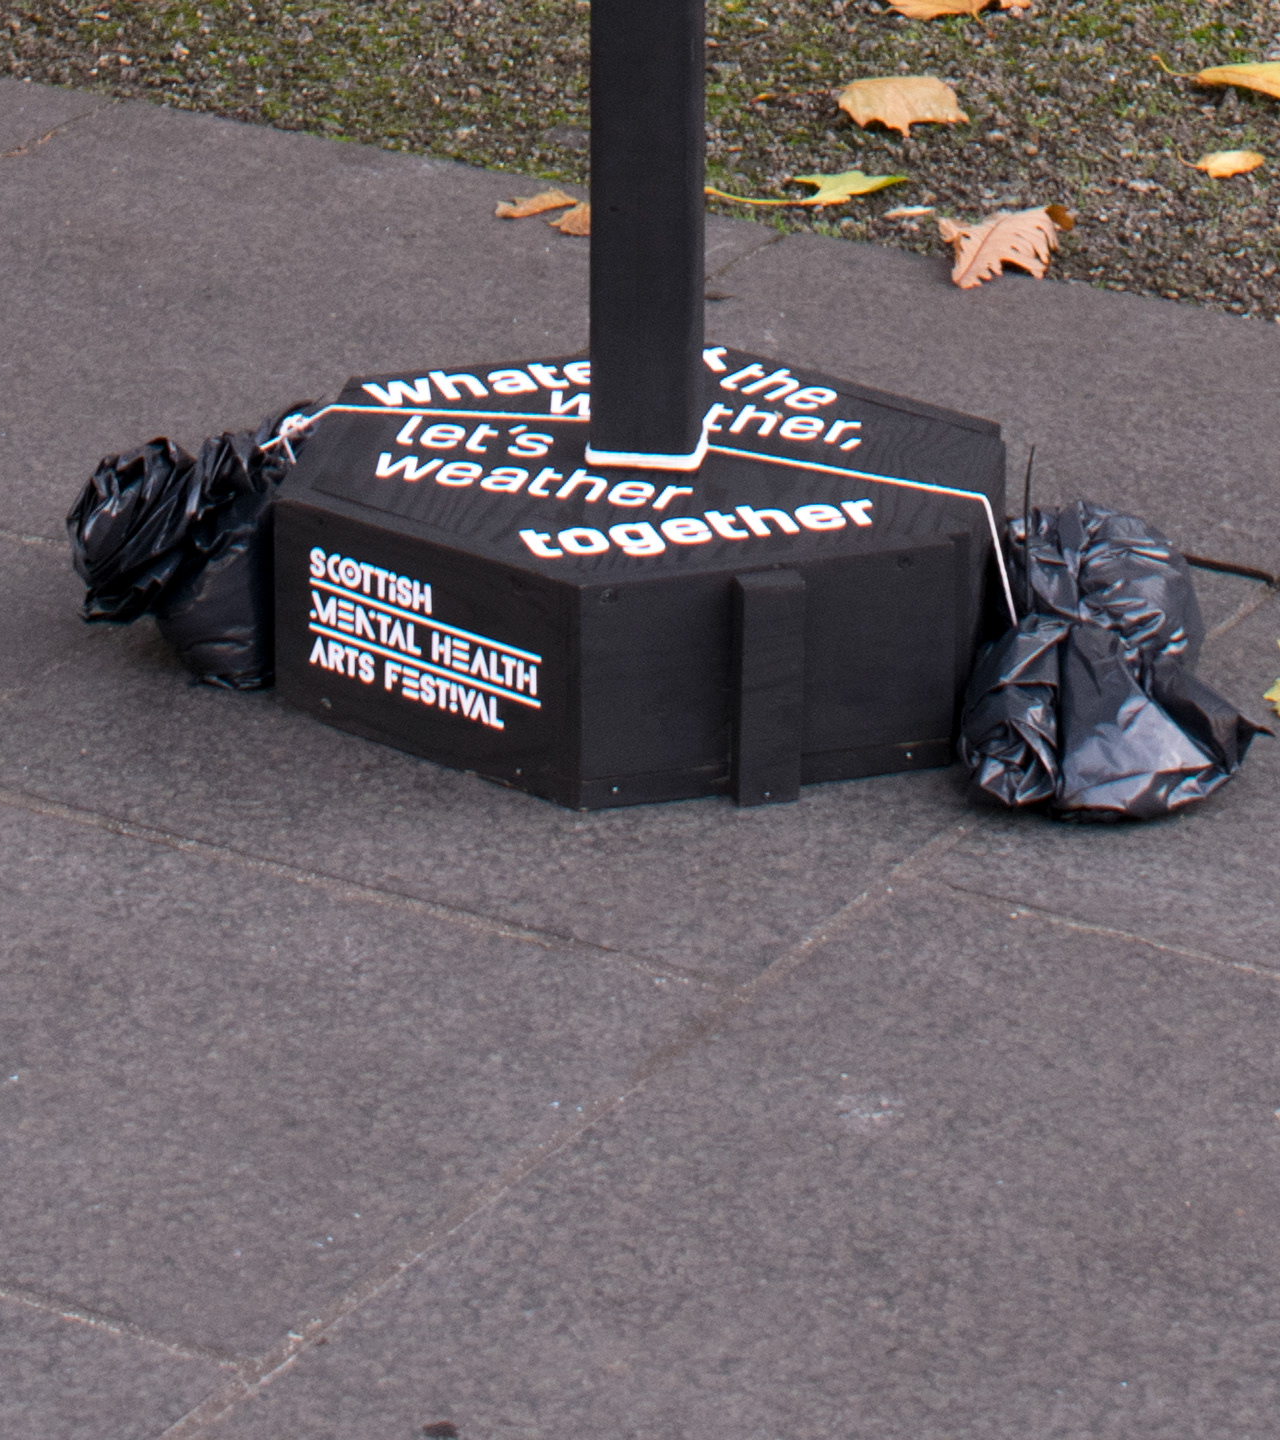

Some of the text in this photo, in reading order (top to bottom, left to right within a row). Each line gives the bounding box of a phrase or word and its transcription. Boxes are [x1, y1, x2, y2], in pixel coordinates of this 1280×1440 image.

[720, 363, 839, 411] the
[395, 415, 555, 459] let's
[374, 452, 694, 510] weather
[519, 498, 874, 558] together
[309, 589, 538, 696] MENTAL HEALTH
[309, 635, 375, 684] ARTS
